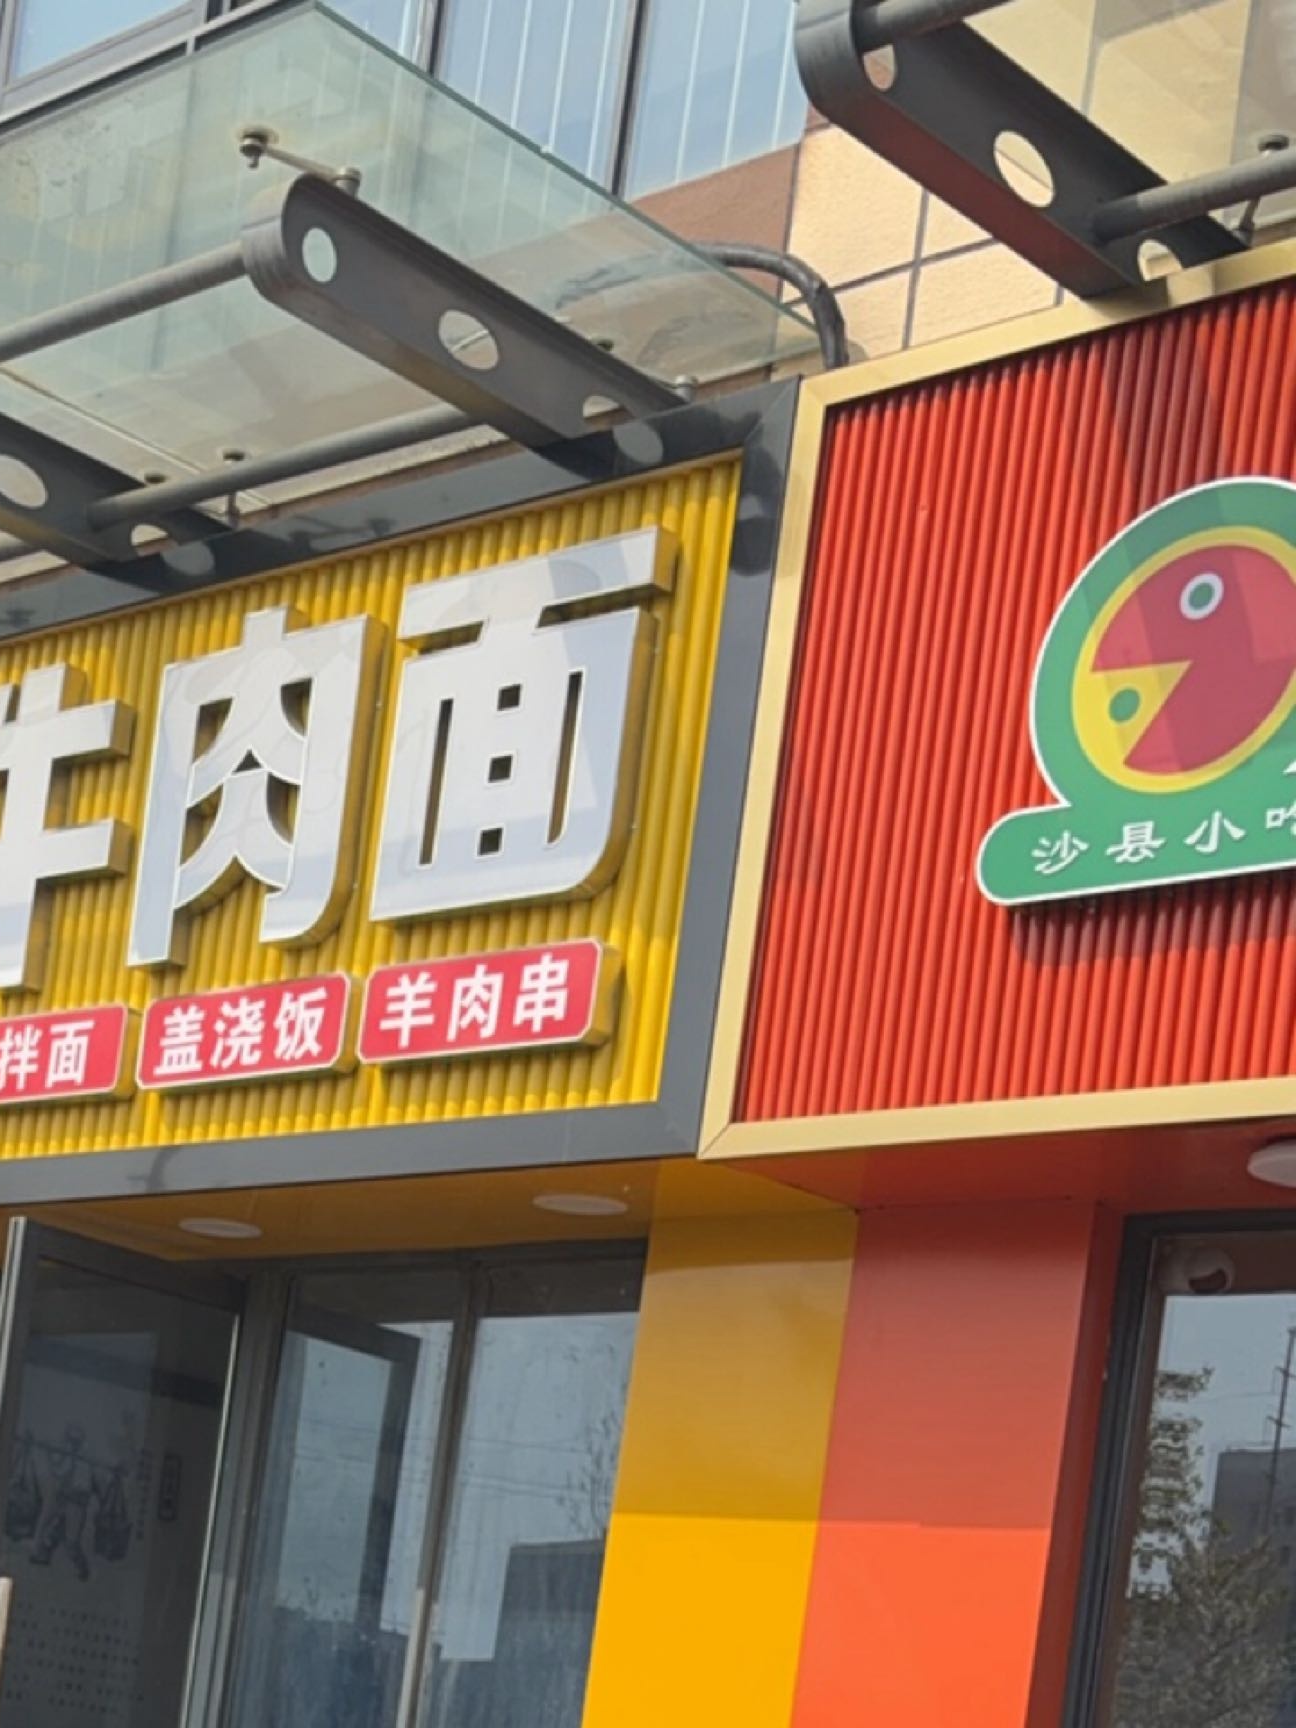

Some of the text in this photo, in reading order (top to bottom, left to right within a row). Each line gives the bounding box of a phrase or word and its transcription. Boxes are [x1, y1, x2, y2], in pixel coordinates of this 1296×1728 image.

[152, 988, 326, 1077] 盖浇饭
[377, 952, 575, 1049] 羊肉串
